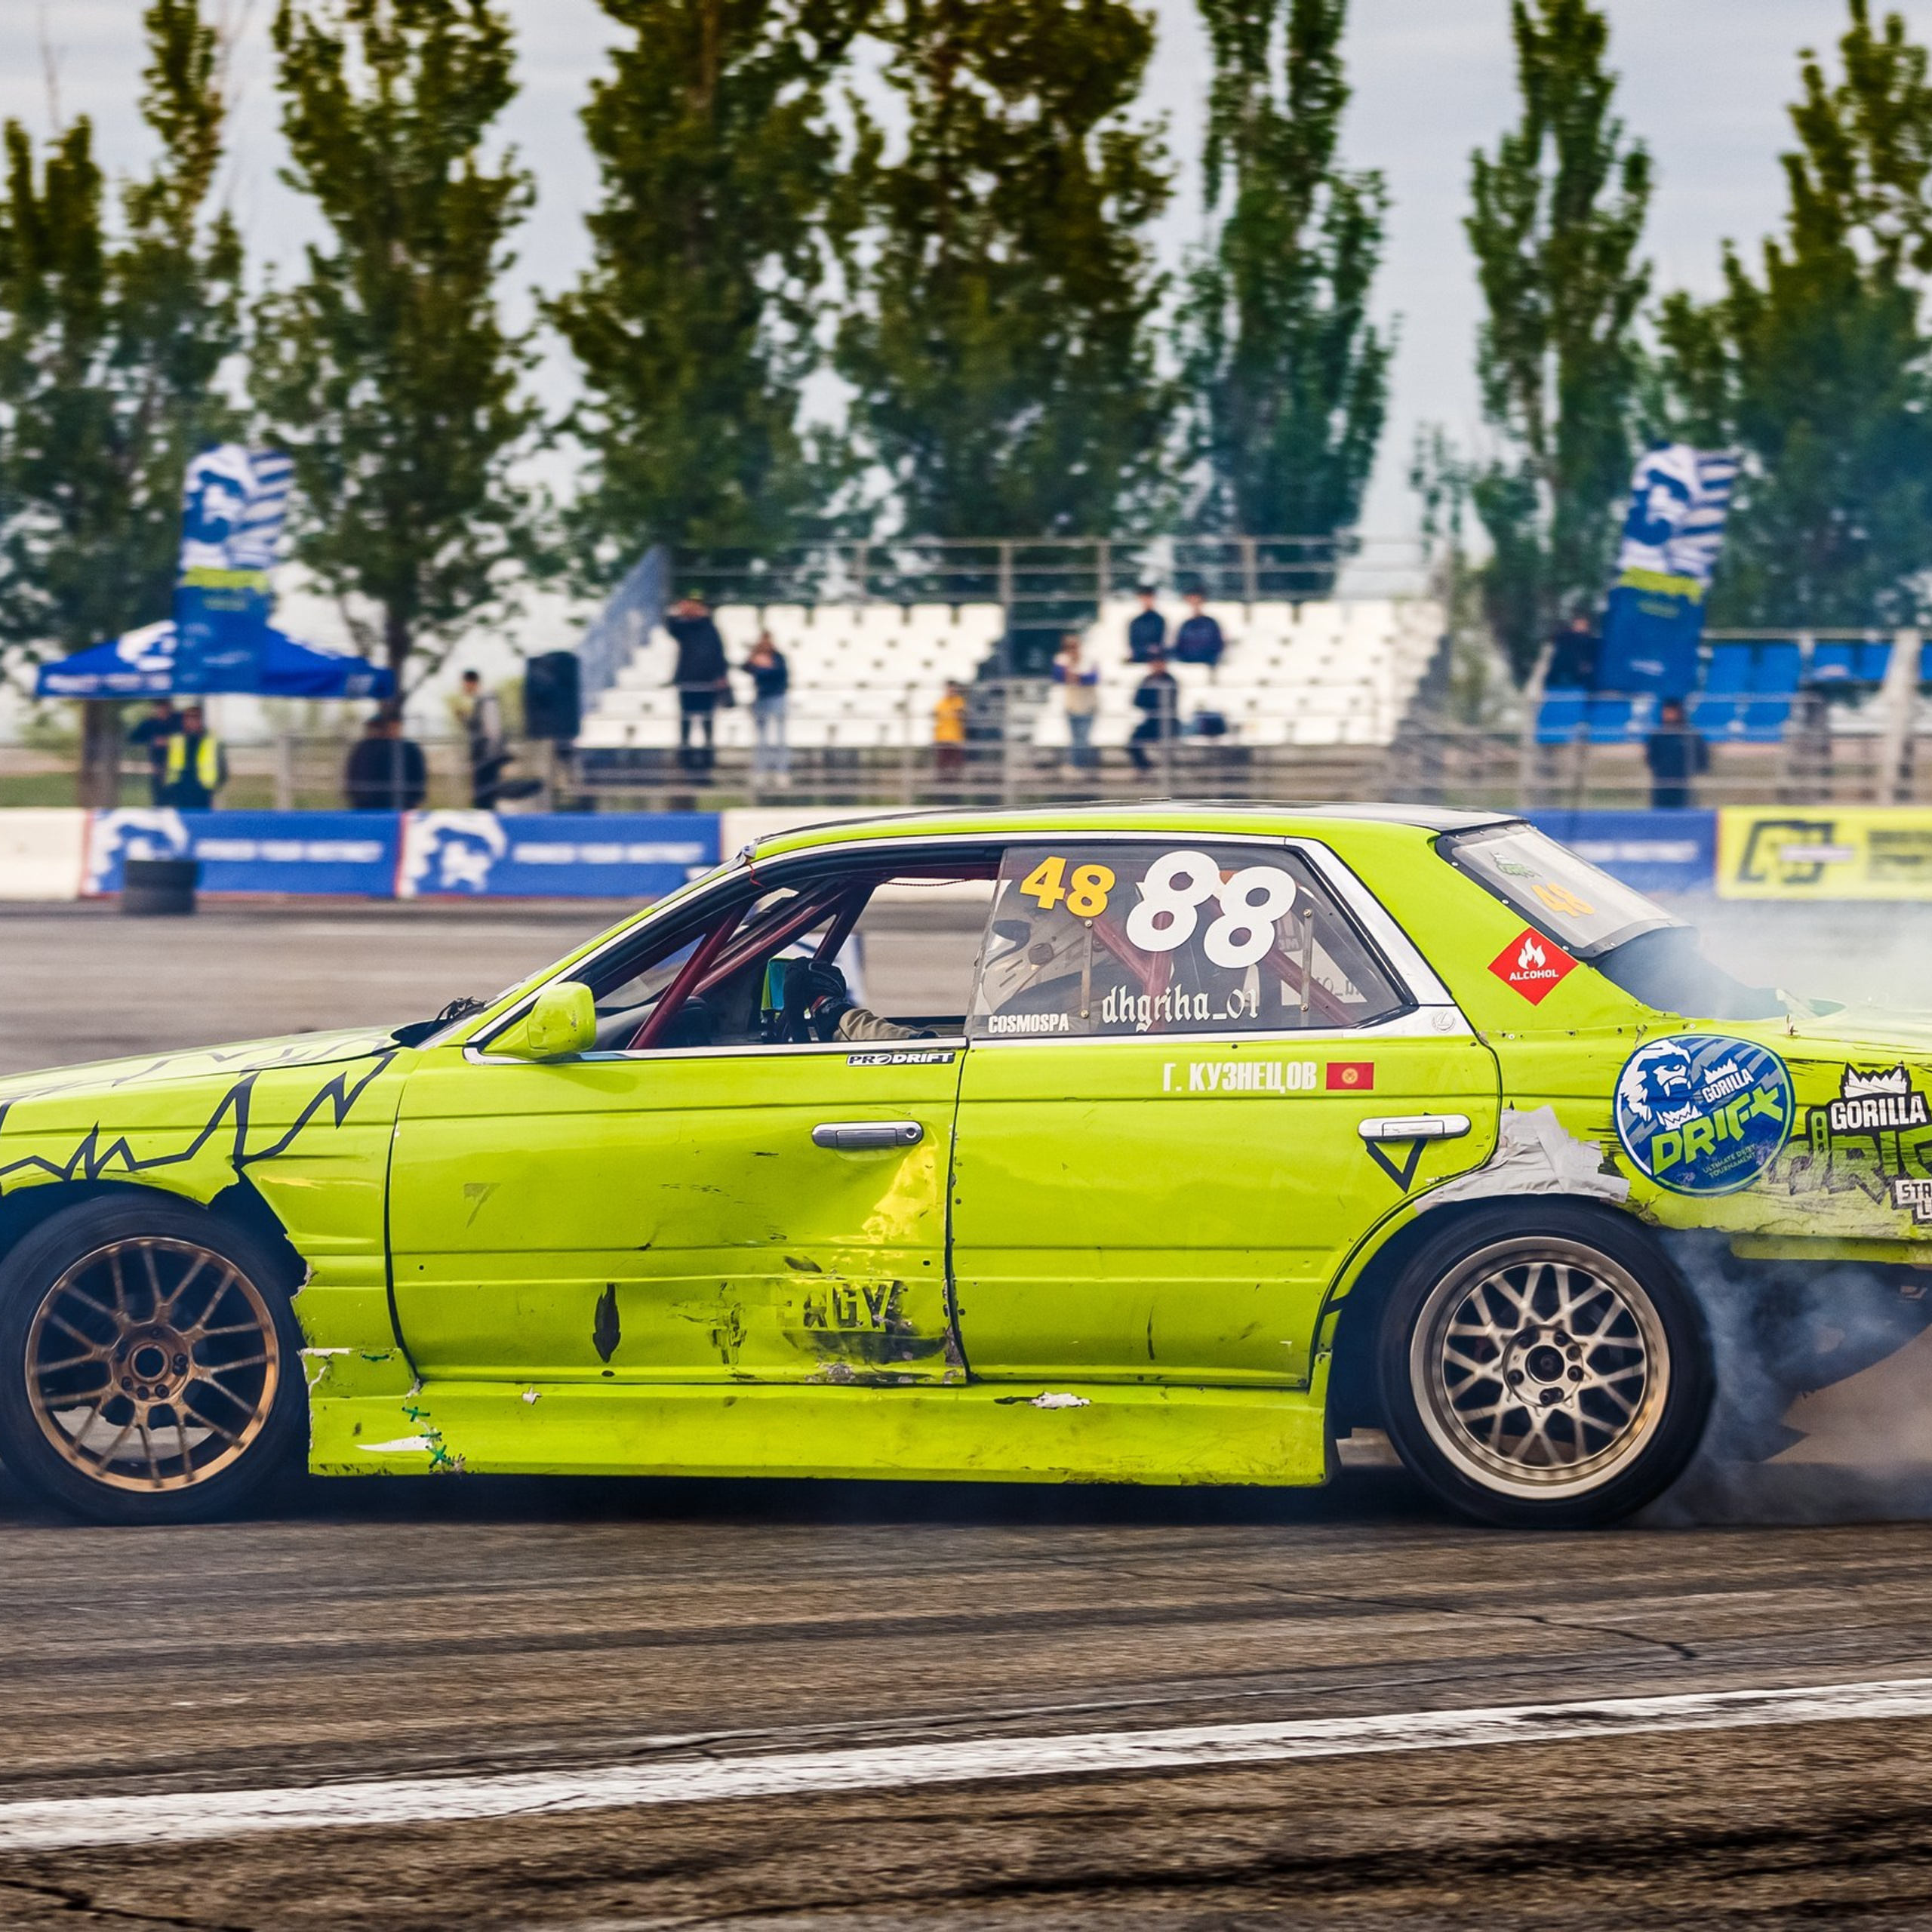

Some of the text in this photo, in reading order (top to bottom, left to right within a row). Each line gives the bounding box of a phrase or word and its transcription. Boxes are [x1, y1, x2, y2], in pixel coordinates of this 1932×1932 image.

[1020, 856, 1115, 917] 48
[1531, 883, 1595, 918] 48
[1126, 851, 1297, 968] 88
[1509, 969, 1559, 981] ALCOHOL
[988, 1013, 1069, 1033] COSMOSPA
[848, 1052, 955, 1066] PRODRIFT
[1163, 1061, 1318, 1094] Г. КУЗНЕЦОВ
[1702, 1068, 1754, 1103] GORILLA
[1830, 1095, 1927, 1131] GORILLA
[1703, 1153, 1736, 1174] ULTIMATE
[1709, 1152, 1757, 1178] TOURNAMENT
